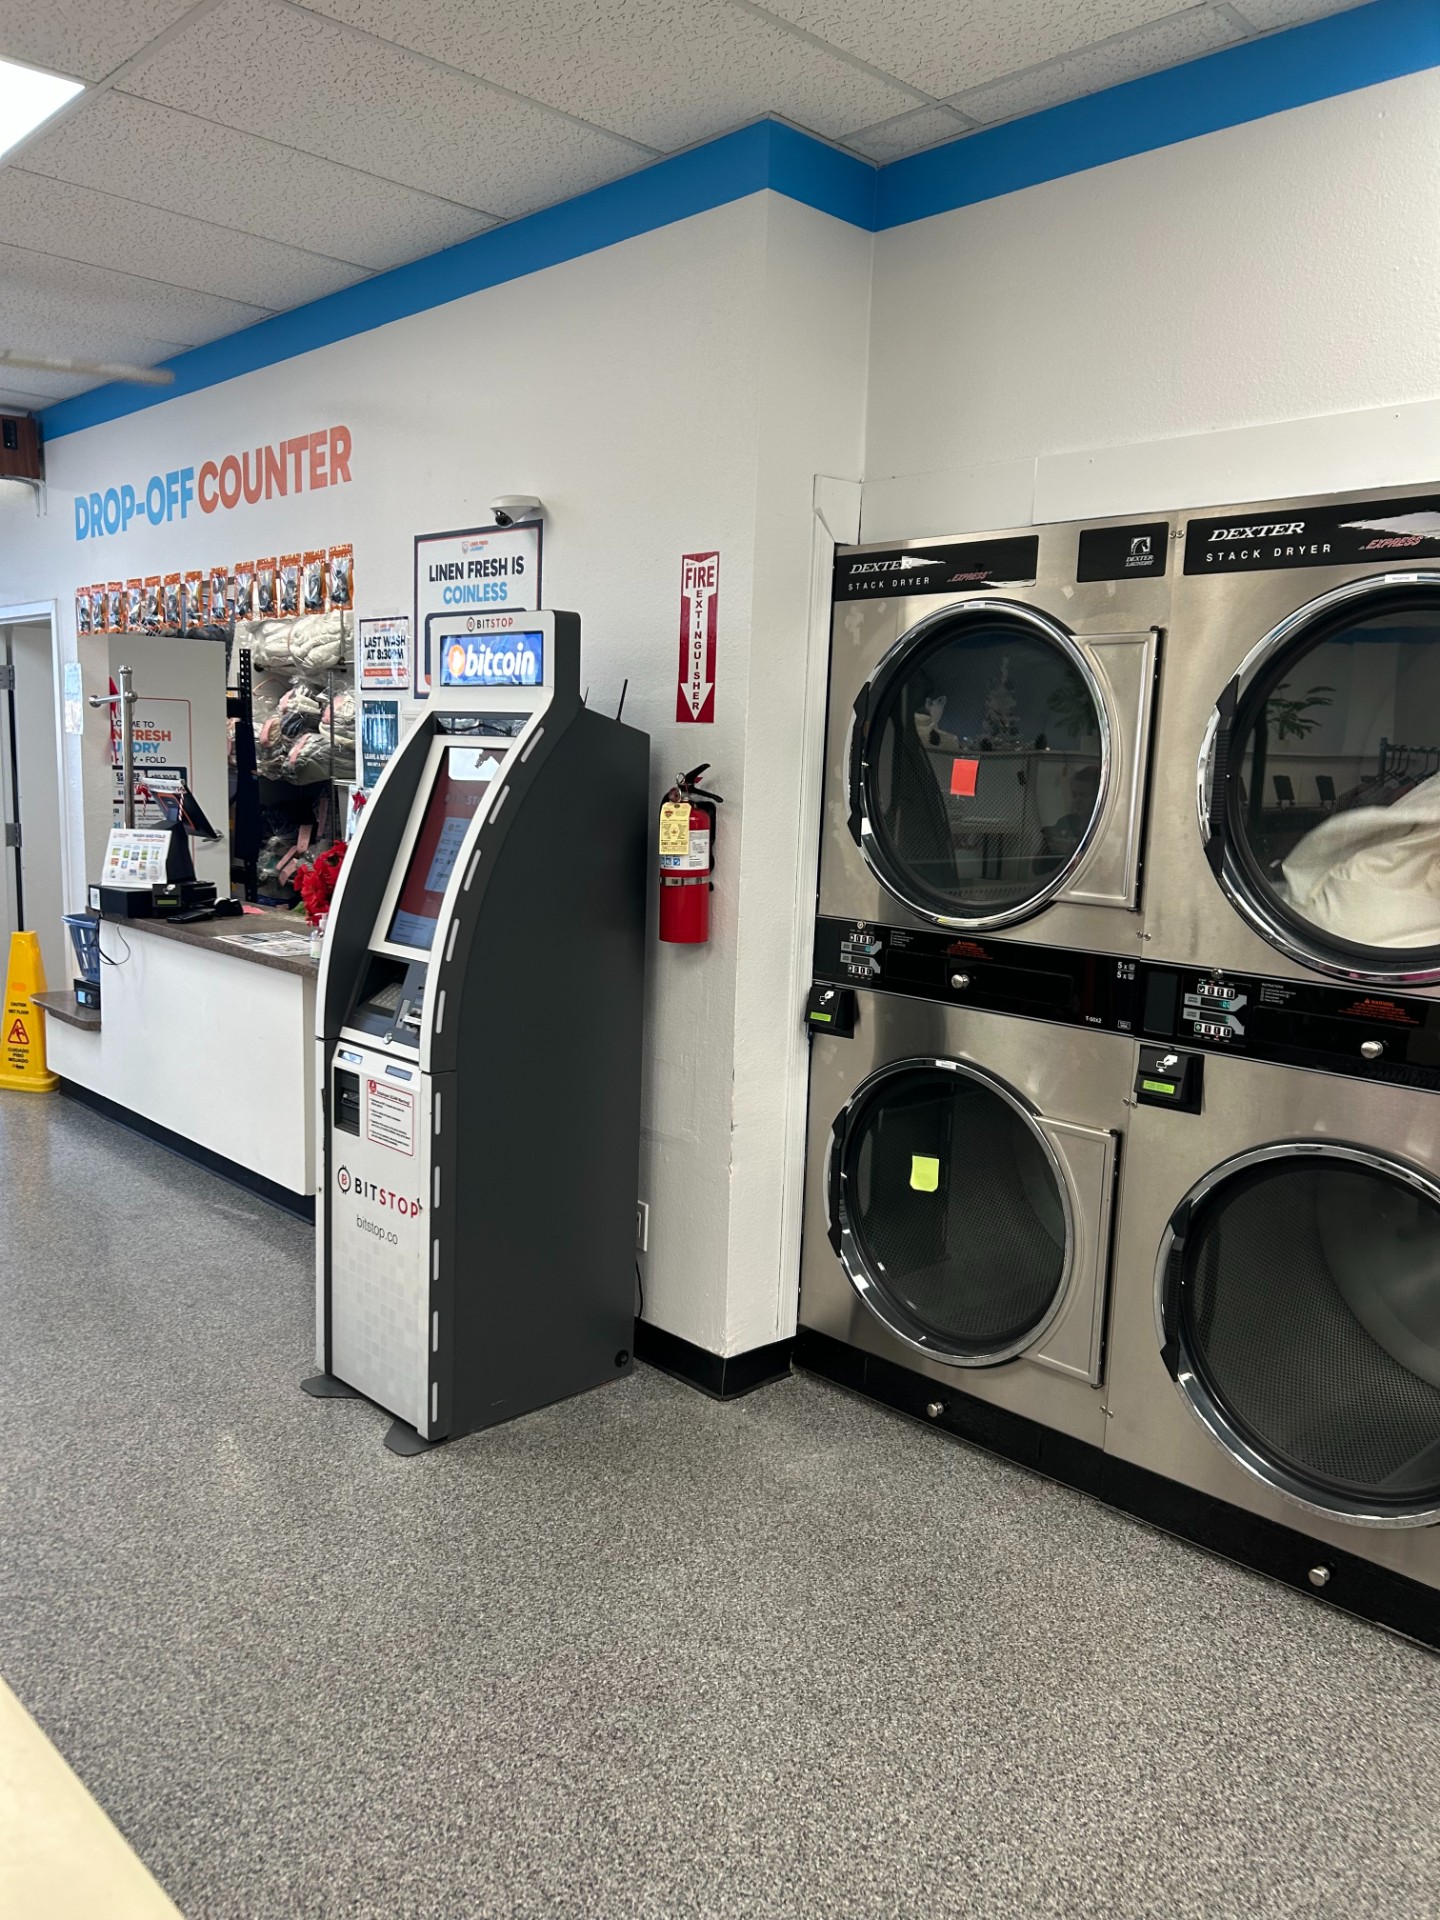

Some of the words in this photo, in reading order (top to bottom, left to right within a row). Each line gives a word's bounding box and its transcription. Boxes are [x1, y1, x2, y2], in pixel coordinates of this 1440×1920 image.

[74, 466, 194, 541] DROP-OFF
[199, 425, 352, 513] COUNTER
[1208, 522, 1305, 541] DEXTER
[1366, 535, 1423, 549] EXPRESS
[1206, 549, 1260, 562] STACK
[1274, 543, 1331, 557] DRYER
[429, 562, 464, 582] LINEN
[468, 557, 508, 579] FRESH
[512, 555, 524, 575] IS
[849, 559, 912, 574] DEXTER
[952, 571, 988, 581] EXPRESS
[685, 565, 715, 589] FIRE
[848, 581, 884, 590] STACK
[892, 577, 930, 587] DRYER
[443, 582, 508, 605] COINLESS
[477, 617, 513, 629] BITSTOP
[364, 636, 381, 648] LAST
[383, 635, 406, 647] WASH
[692, 589, 703, 710] EXTINGUISHER
[367, 650, 375, 660] AT
[464, 642, 535, 676] bitcoin
[146, 756, 166, 764] FOLD
[355, 1177, 419, 1219] BITSTOP
[356, 1213, 398, 1245] bitstop.co
